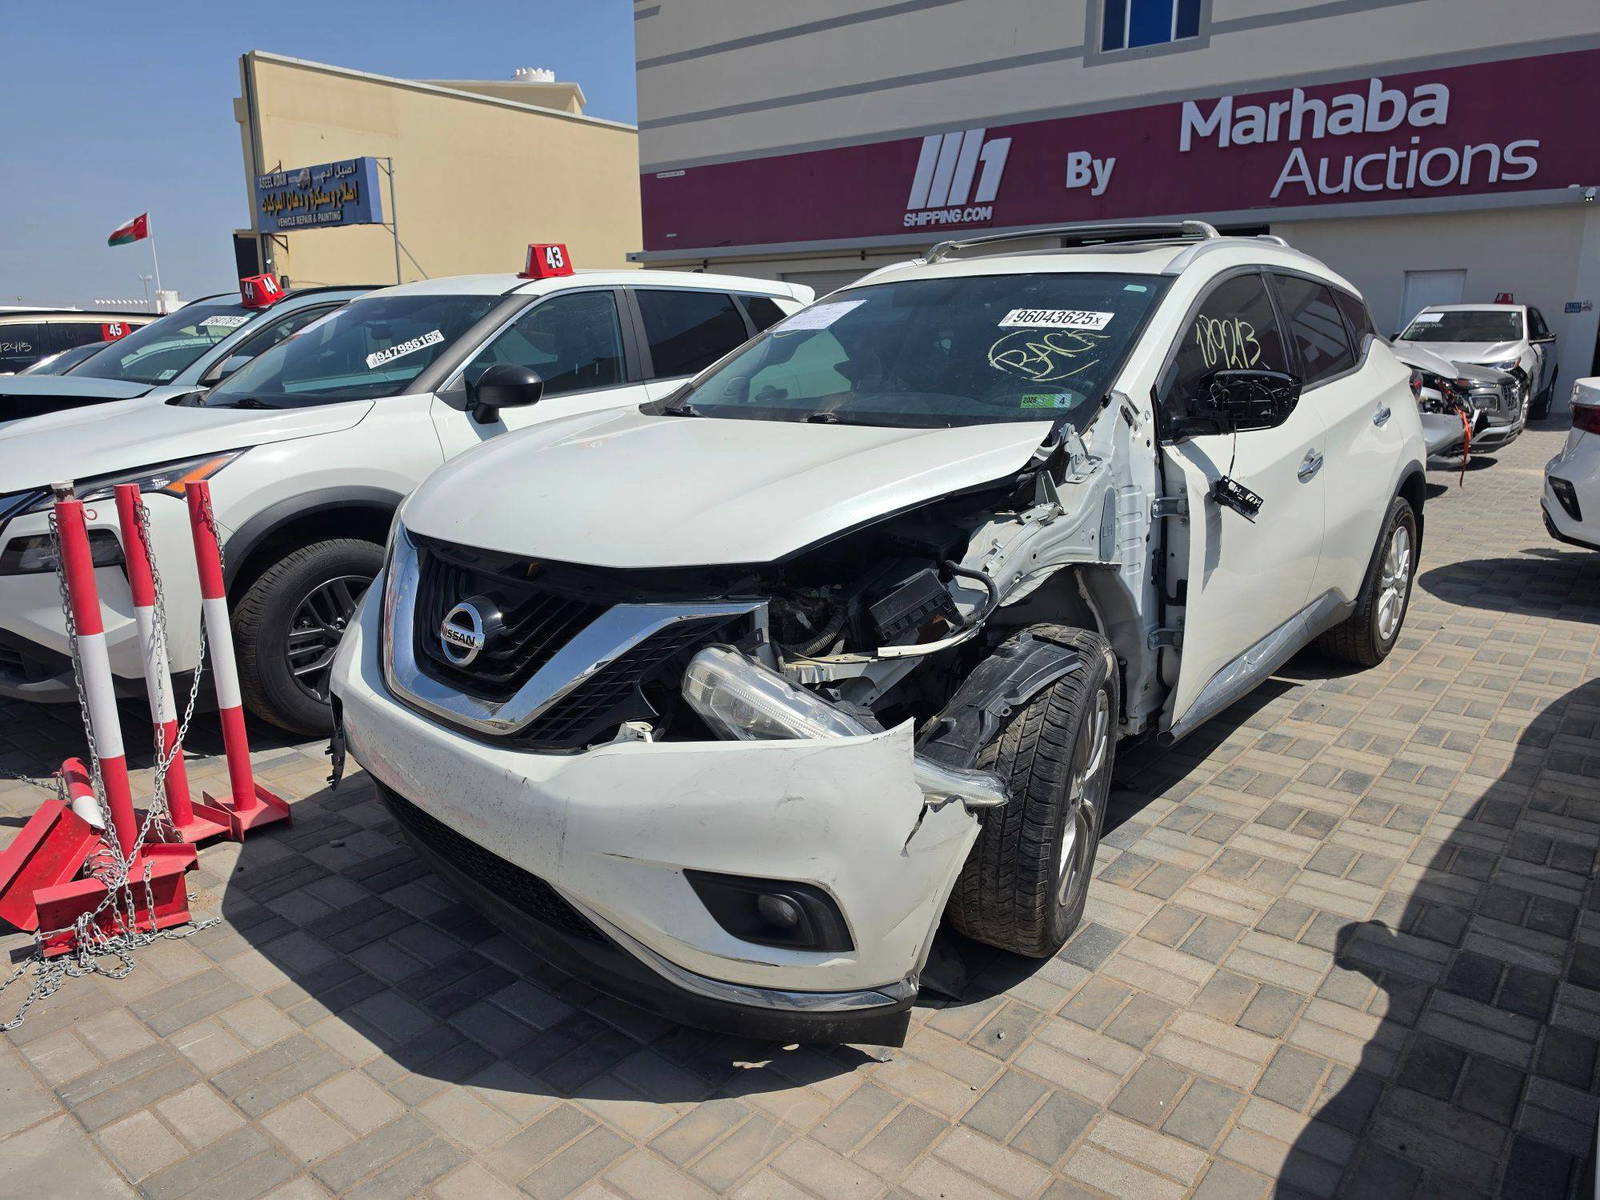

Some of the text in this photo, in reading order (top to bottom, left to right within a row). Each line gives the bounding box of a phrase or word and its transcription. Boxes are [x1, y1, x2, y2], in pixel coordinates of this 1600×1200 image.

[1179, 77, 1450, 152] Marhaba
[1066, 150, 1117, 197] By
[1269, 135, 1540, 199] Auctions
[278, 216, 296, 228] VEHICLE
[296, 213, 313, 226] REPAIR
[318, 210, 342, 223] PAINTING
[903, 205, 993, 228] SHIPPING.COM
[546, 246, 564, 269] 43
[263, 276, 278, 295] 44
[109, 323, 122, 337] 45
[1059, 396, 1066, 405] 4
[442, 623, 475, 647] NISSAN
